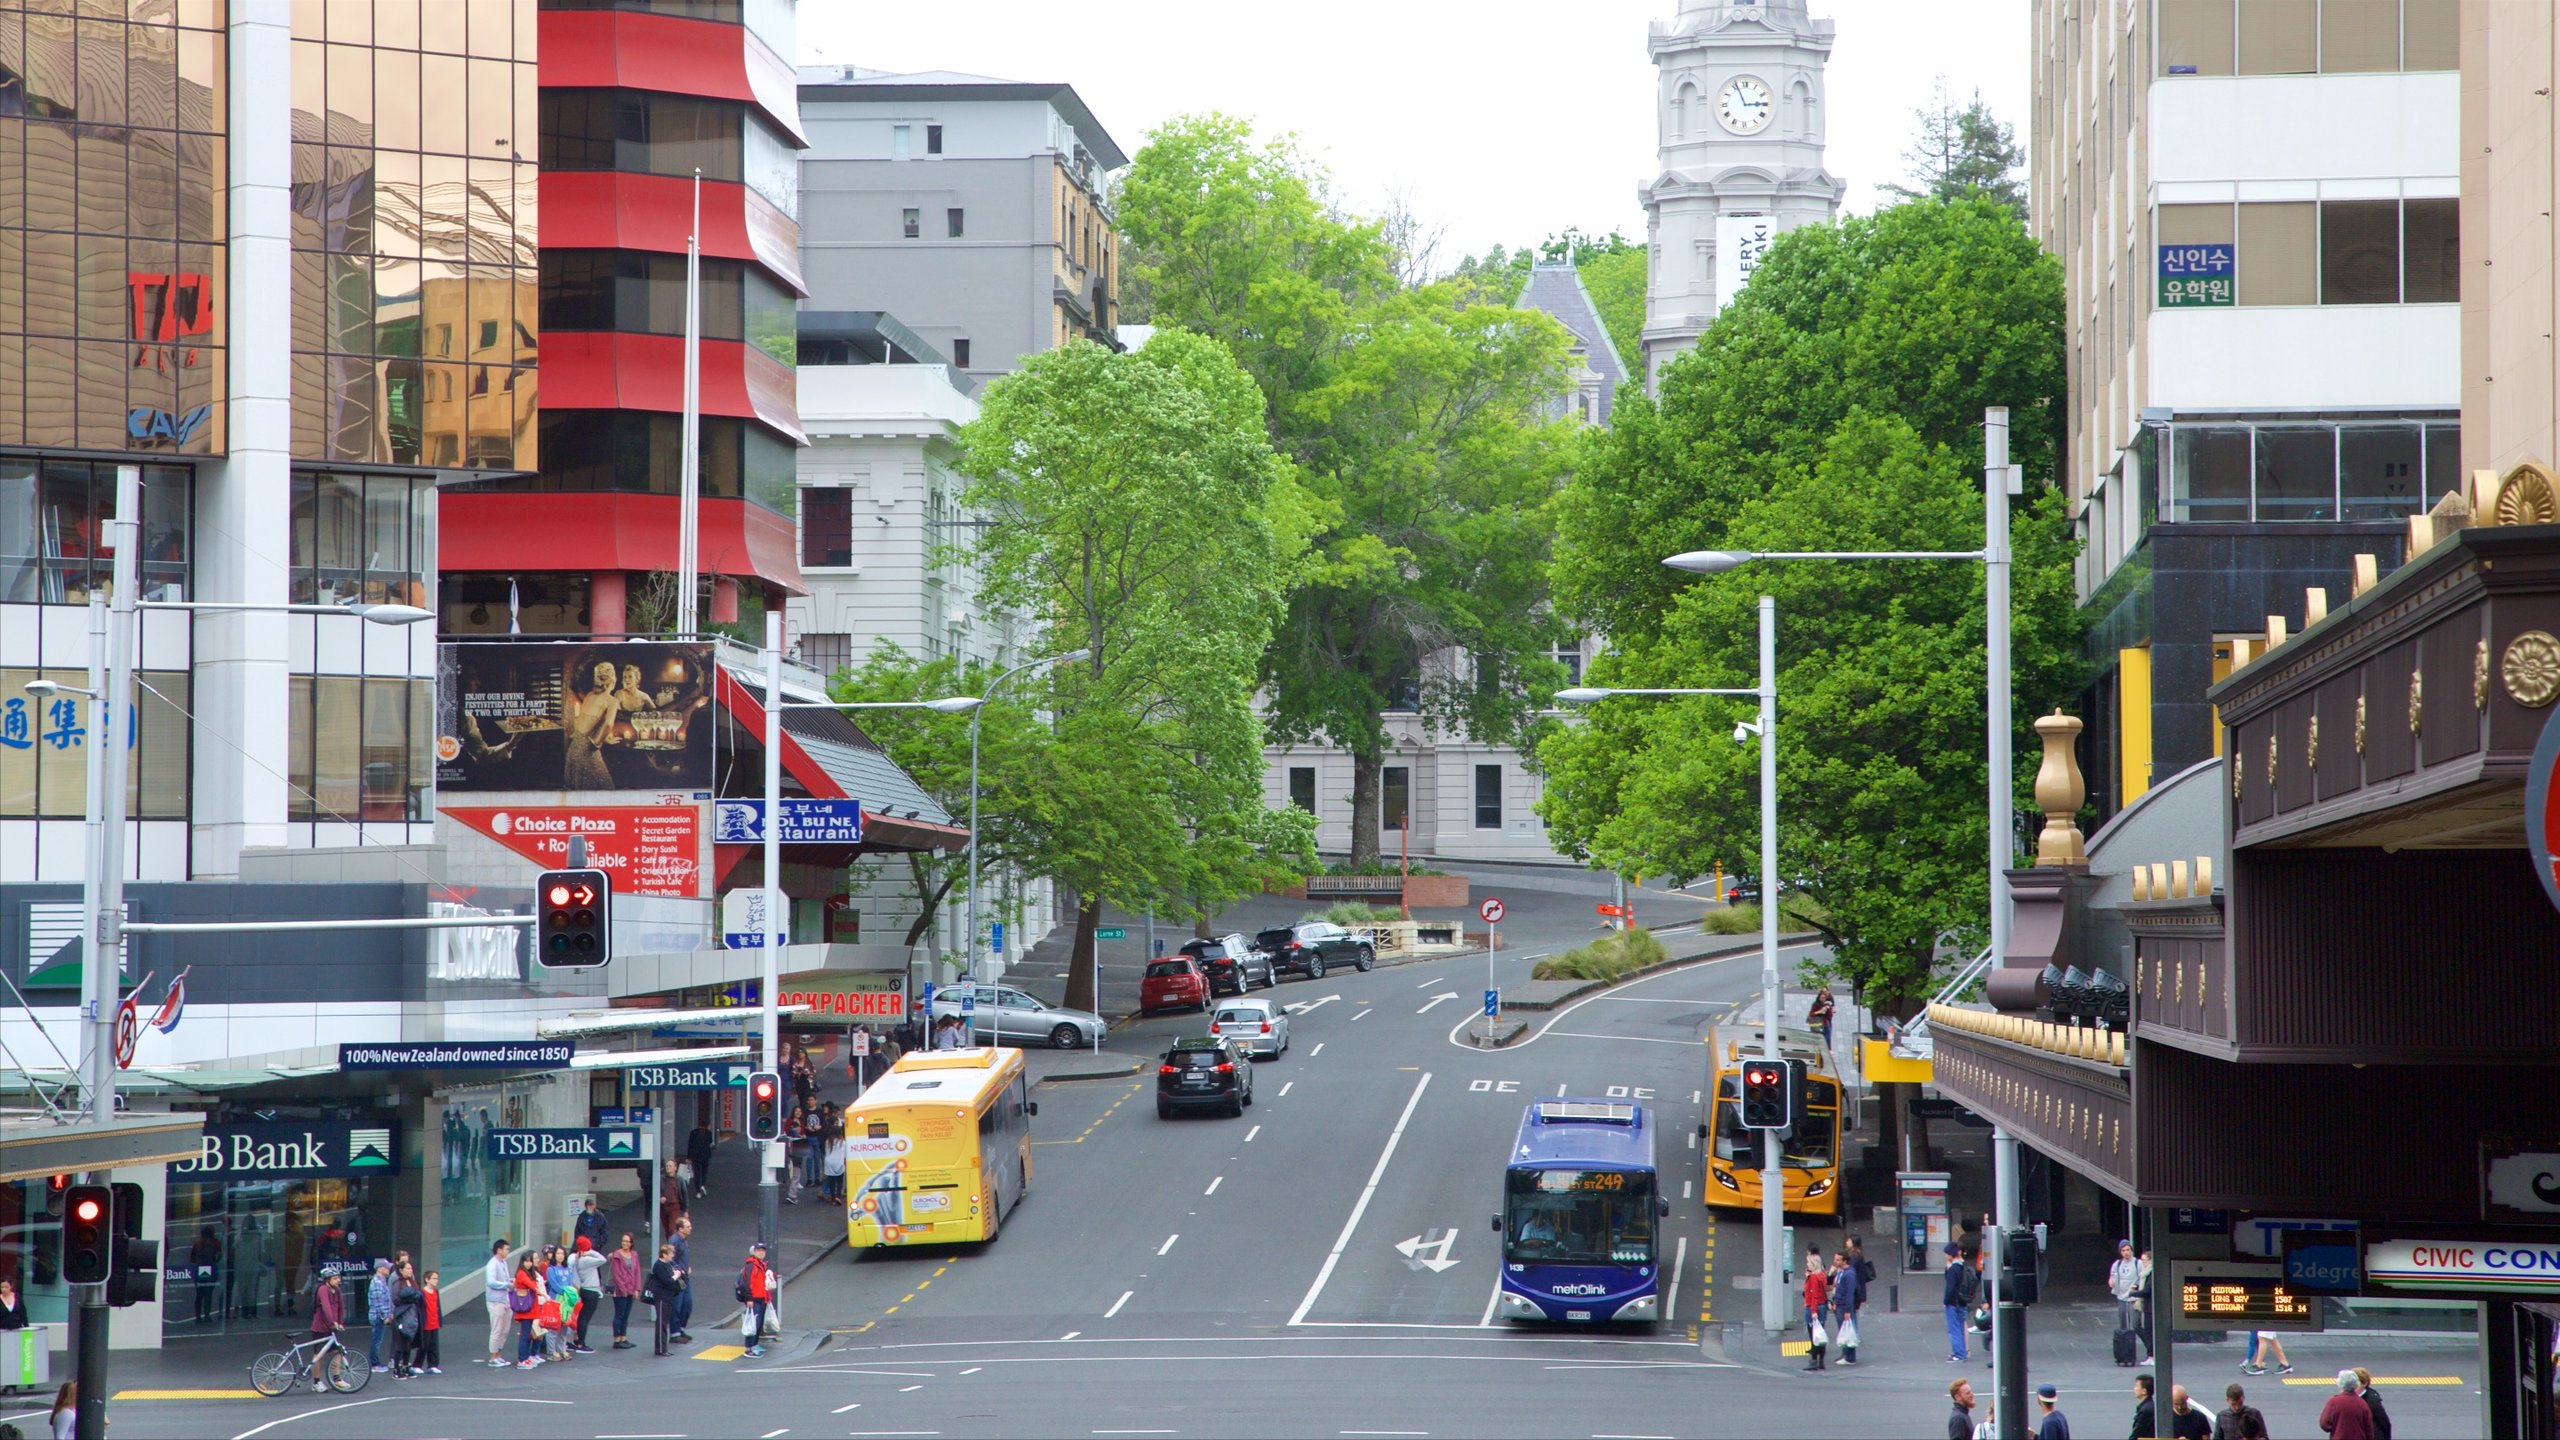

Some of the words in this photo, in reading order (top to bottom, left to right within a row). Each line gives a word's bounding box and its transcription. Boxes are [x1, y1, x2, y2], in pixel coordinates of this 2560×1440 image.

[2164, 249, 2230, 272] 신인수
[2164, 280, 2230, 303] 유학원
[465, 693, 486, 701] ENJOY
[487, 693, 501, 701] OUR
[465, 701, 505, 709] FESTIVITIES
[526, 700, 548, 708] PARTY
[465, 709, 473, 717] OF
[515, 816, 567, 831] Choice
[571, 816, 616, 831] Plaza
[642, 816, 691, 824] Accomodation
[803, 817, 823, 827] BU
[829, 817, 852, 827] NE
[641, 826, 664, 835] Secret
[666, 826, 691, 834] Garden
[641, 834, 677, 842] Restaurant
[549, 838, 595, 852] Ros
[641, 845, 658, 855] Dory
[659, 845, 678, 853] Sushi
[585, 853, 627, 868] ailable
[641, 877, 665, 886] Turkish
[777, 992, 903, 1016] ACKPACKER
[345, 1049, 381, 1063] 100%
[381, 1049, 410, 1063] New
[411, 1048, 461, 1062] Zealand
[462, 1047, 506, 1062] owned
[506, 1046, 539, 1061] since
[539, 1046, 569, 1061] 1850
[630, 1068, 665, 1086] TSB
[667, 1067, 718, 1086] Bank
[493, 1134, 537, 1155] TSB
[540, 1133, 597, 1154] Bank
[850, 1142, 894, 1153] NUROMOL
[230, 1132, 328, 1171] Bank
[1594, 1173, 1624, 1191] 249
[2412, 1247, 2474, 1268] CIVIC
[343, 1260, 368, 1271] Bank
[166, 1269, 192, 1280] Bank
[1552, 1284, 1606, 1296] metrolink
[2183, 1286, 2198, 1294] 249
[2211, 1286, 2244, 1294] MIDTOWN
[2211, 1295, 2231, 1303] LONG
[2234, 1295, 2249, 1303] BAY
[2274, 1296, 2293, 1304] 1507
[2211, 1303, 2244, 1311] MIDTOWN
